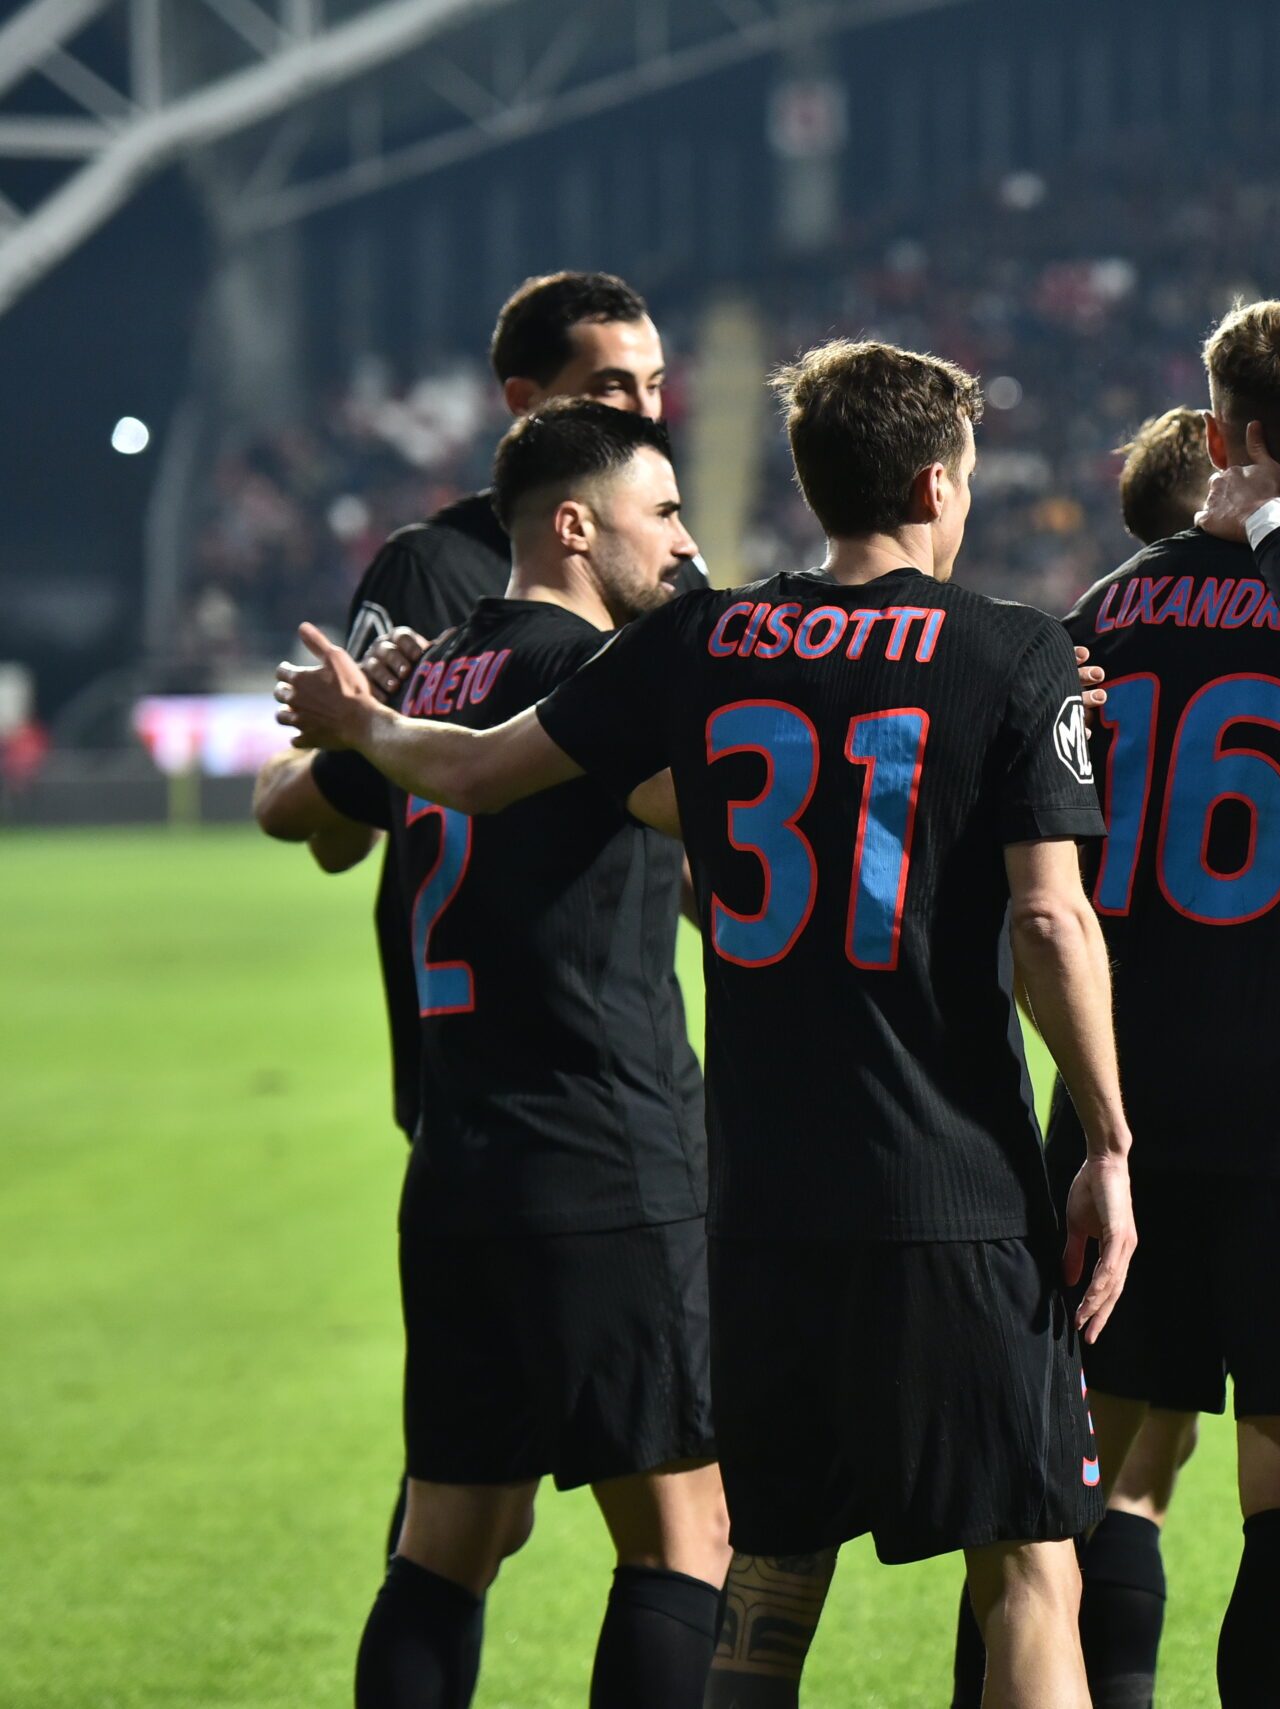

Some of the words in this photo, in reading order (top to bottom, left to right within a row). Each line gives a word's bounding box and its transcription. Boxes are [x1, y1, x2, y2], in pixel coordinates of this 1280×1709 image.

[401, 649, 513, 716] CRETU
[708, 602, 946, 662] CISOTTI
[406, 792, 475, 1017] 2
[705, 699, 930, 971] 31
